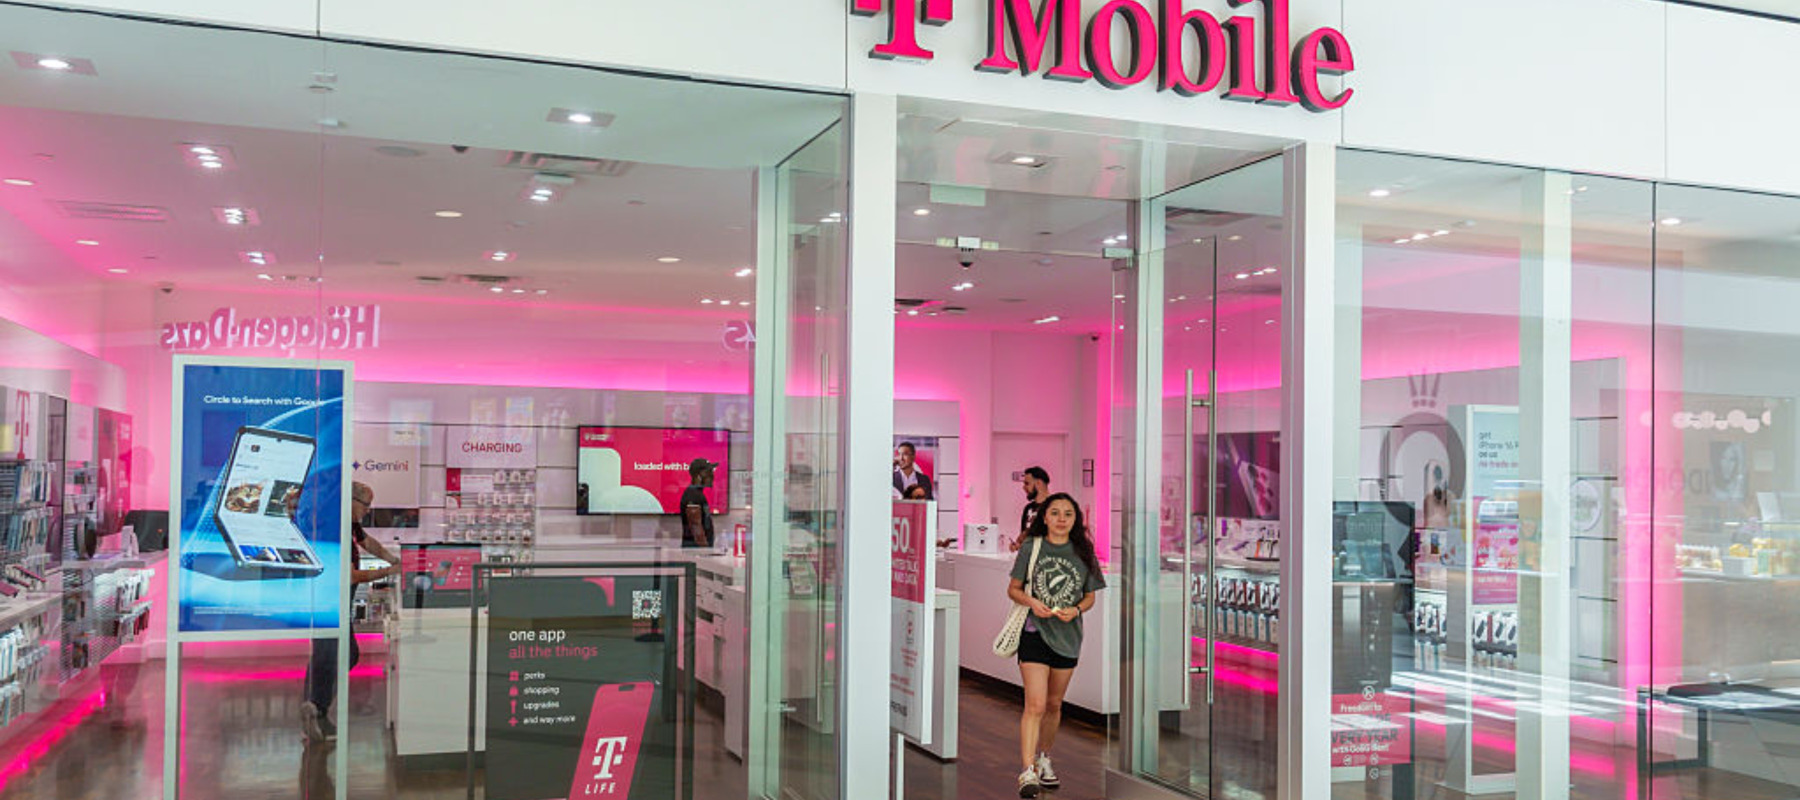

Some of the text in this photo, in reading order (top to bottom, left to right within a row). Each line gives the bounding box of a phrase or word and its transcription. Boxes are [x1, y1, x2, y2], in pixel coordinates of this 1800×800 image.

[974, 0, 1355, 112] Mobile
[203, 394, 230, 404] Circle
[231, 396, 241, 404] to
[242, 396, 273, 405] Search
[274, 397, 292, 405] with
[462, 441, 522, 453] CHARGING
[364, 459, 409, 472] Gemini
[634, 462, 663, 471] loaded
[664, 462, 682, 471] with
[509, 629, 566, 644] one app
[508, 643, 599, 661] all the things
[523, 671, 546, 680] perks
[523, 685, 560, 696] shopping
[523, 700, 560, 710] upgrades
[523, 714, 576, 726] and way more
[592, 736, 628, 780] T
[585, 782, 616, 795] LIFE
